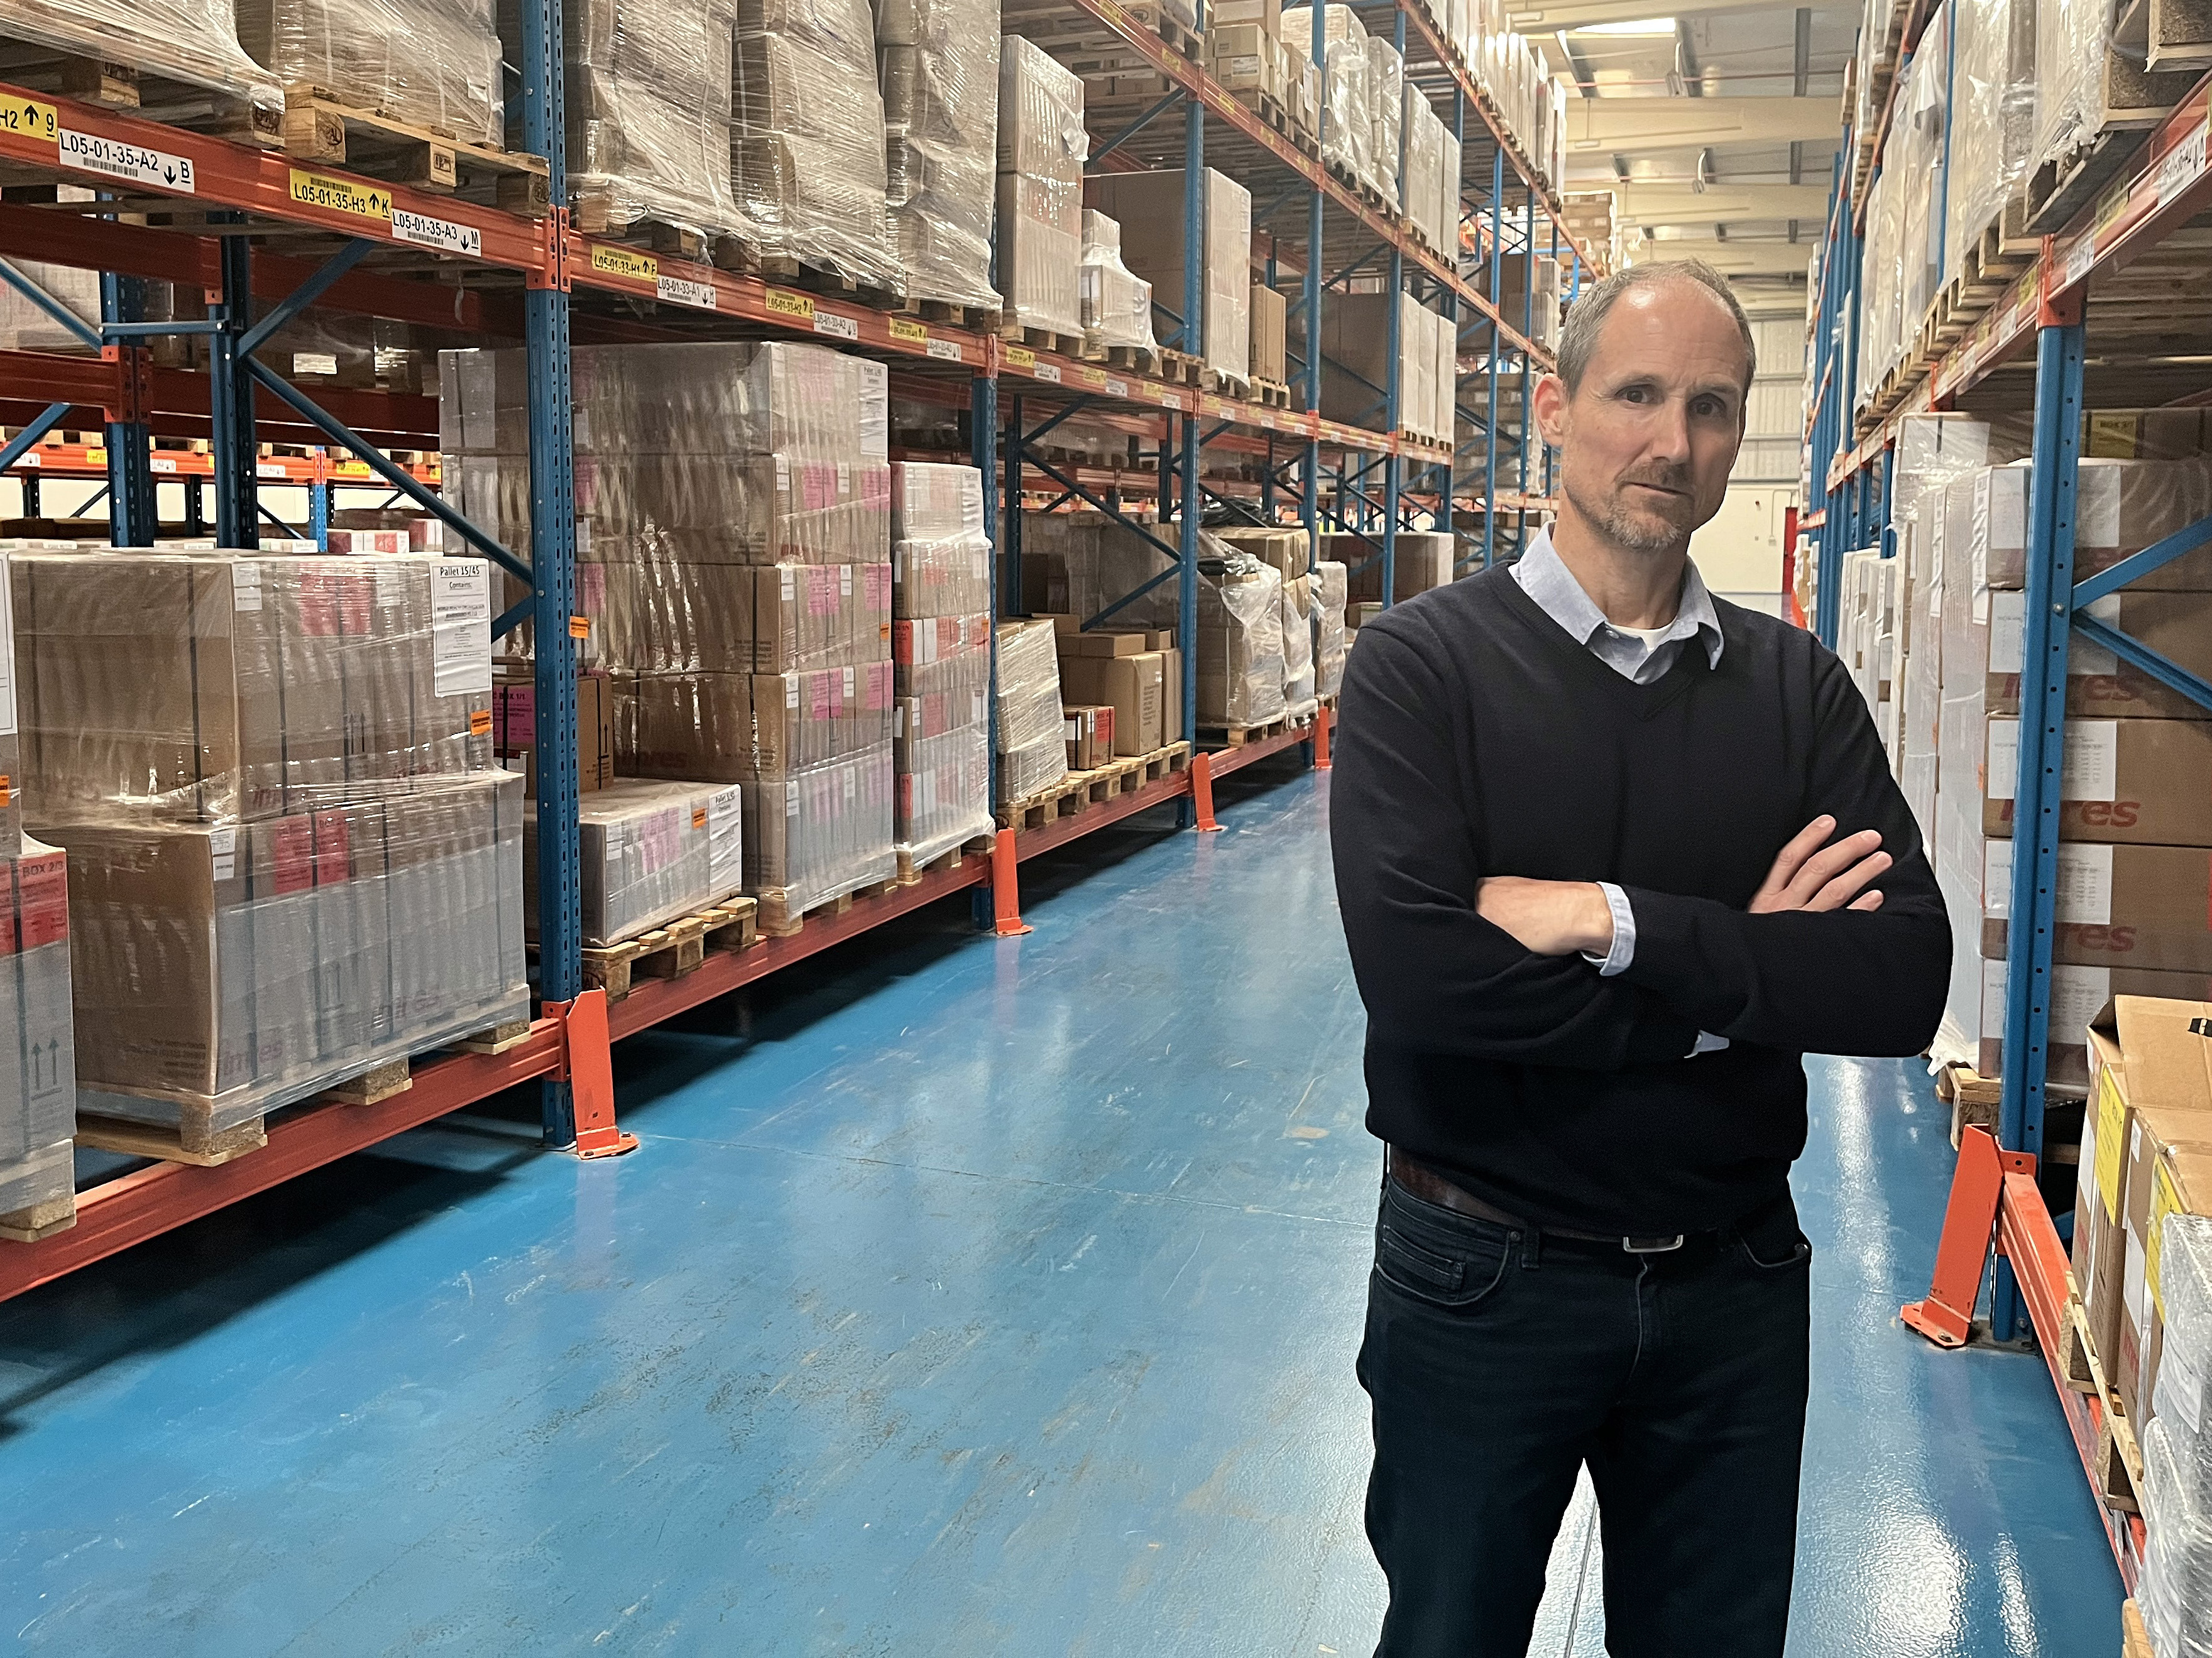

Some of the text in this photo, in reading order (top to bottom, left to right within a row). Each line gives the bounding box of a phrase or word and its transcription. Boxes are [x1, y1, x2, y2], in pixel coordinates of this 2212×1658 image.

[47, 113, 55, 132] 9
[60, 132, 190, 178] L05-01-35-A2 B
[294, 183, 390, 214] L05-01-35-H3 K
[392, 211, 479, 246] L05-01-35-A3 M
[594, 254, 640, 276] L05-01-33-H1
[440, 565, 479, 577] Pallet 15/45
[23, 864, 45, 878] BOX
